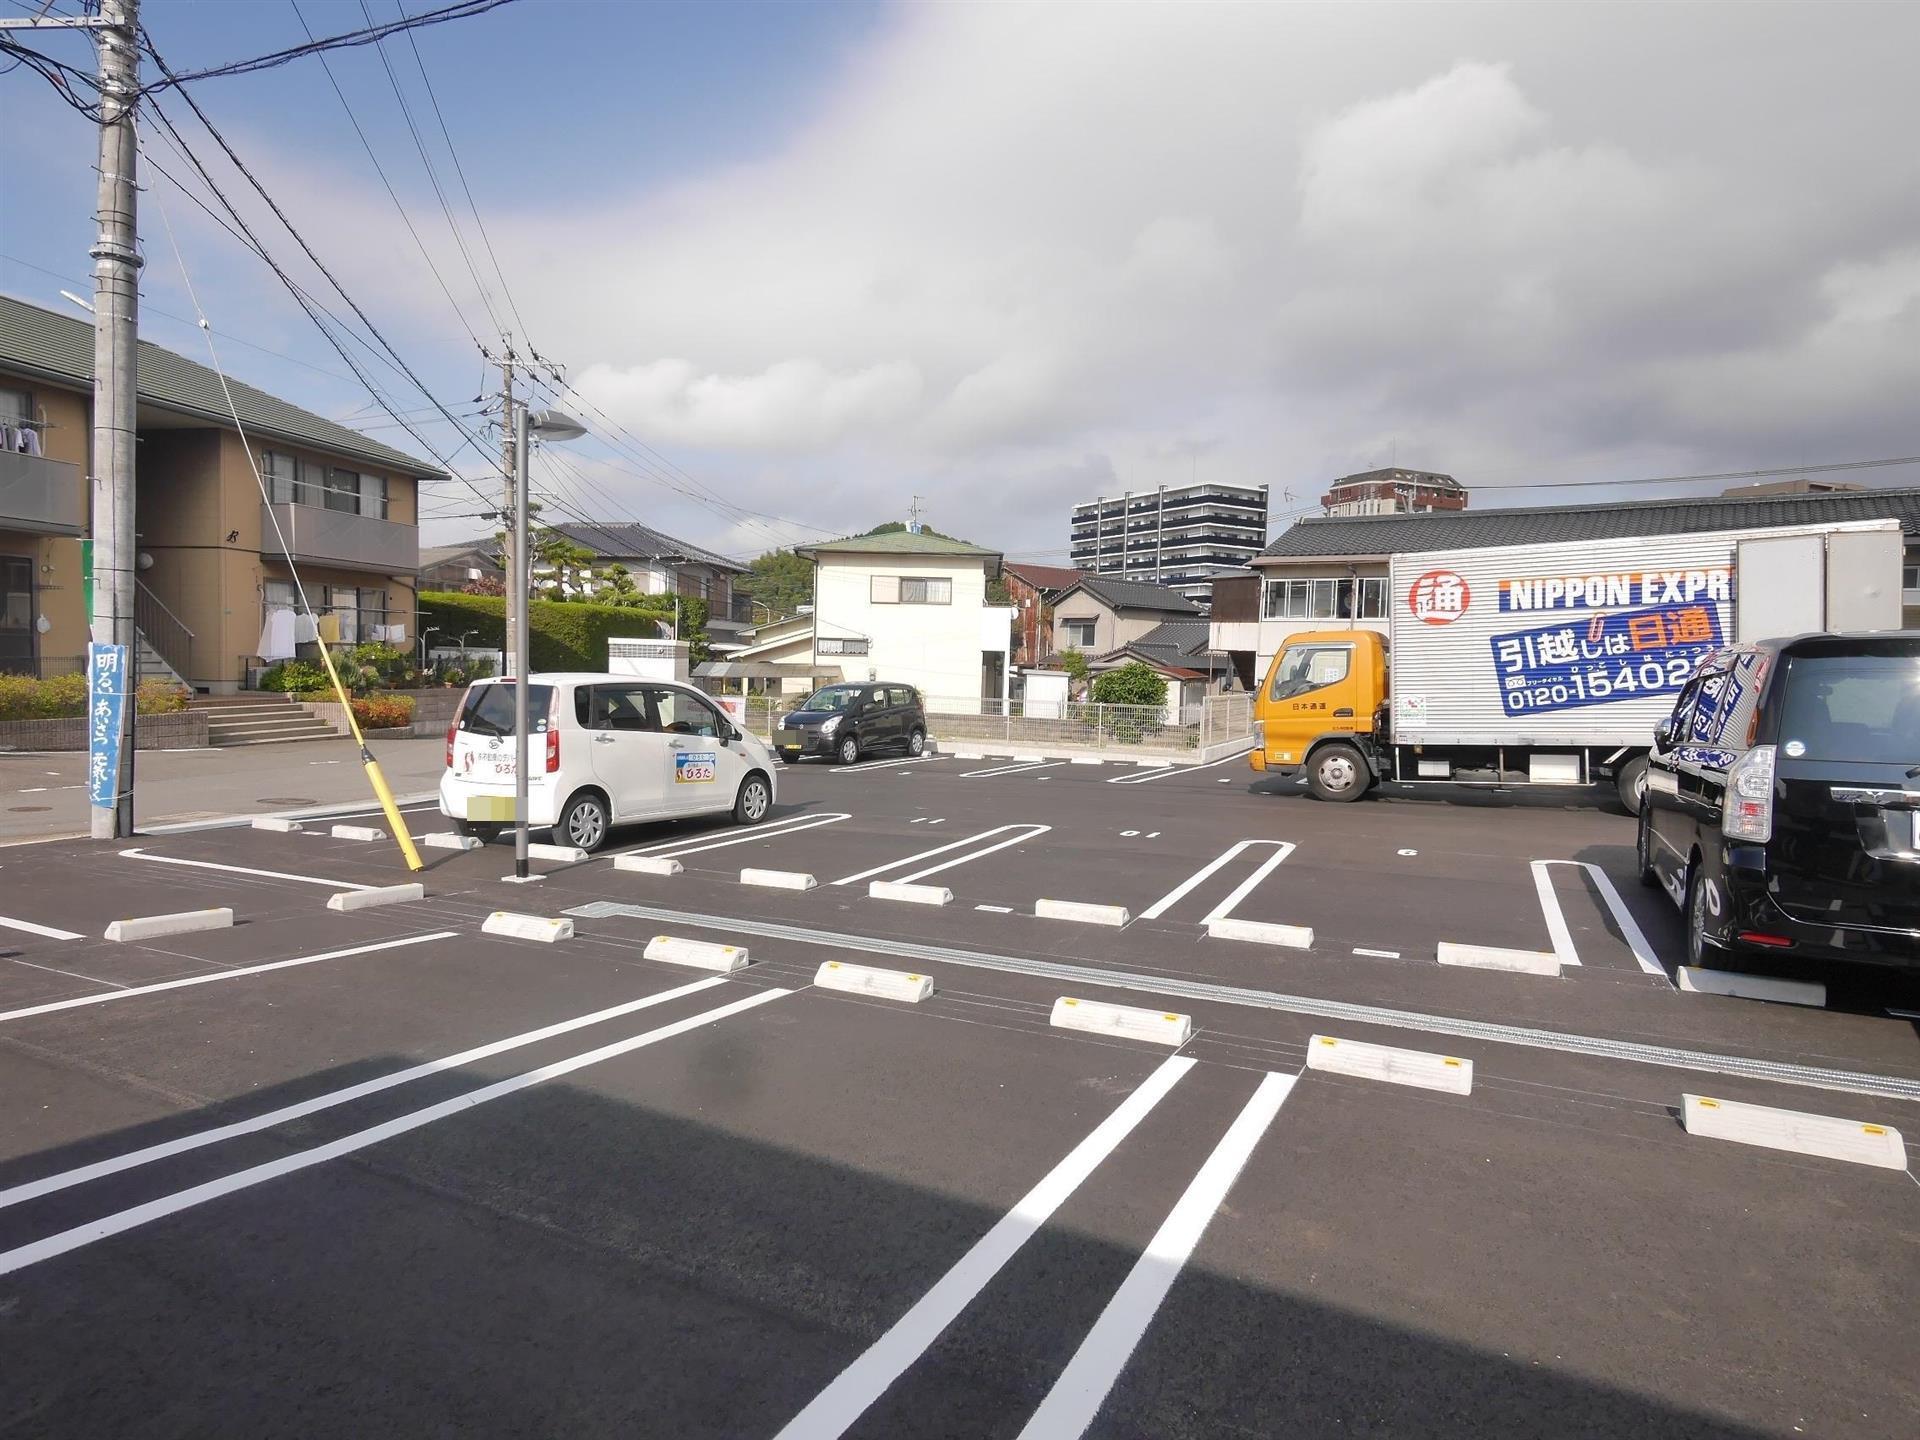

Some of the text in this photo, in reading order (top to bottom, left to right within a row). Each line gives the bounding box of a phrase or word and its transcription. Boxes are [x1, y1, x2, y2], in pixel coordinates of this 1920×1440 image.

[1416, 574, 1464, 622] 通
[1509, 574, 1631, 610] NIPPON
[1498, 606, 1714, 673] 引越しは日通
[95, 653, 118, 694] 明るい
[94, 699, 112, 745] あいさつ
[1292, 702, 1327, 711] 日本通運
[686, 768, 711, 779] ひろた
